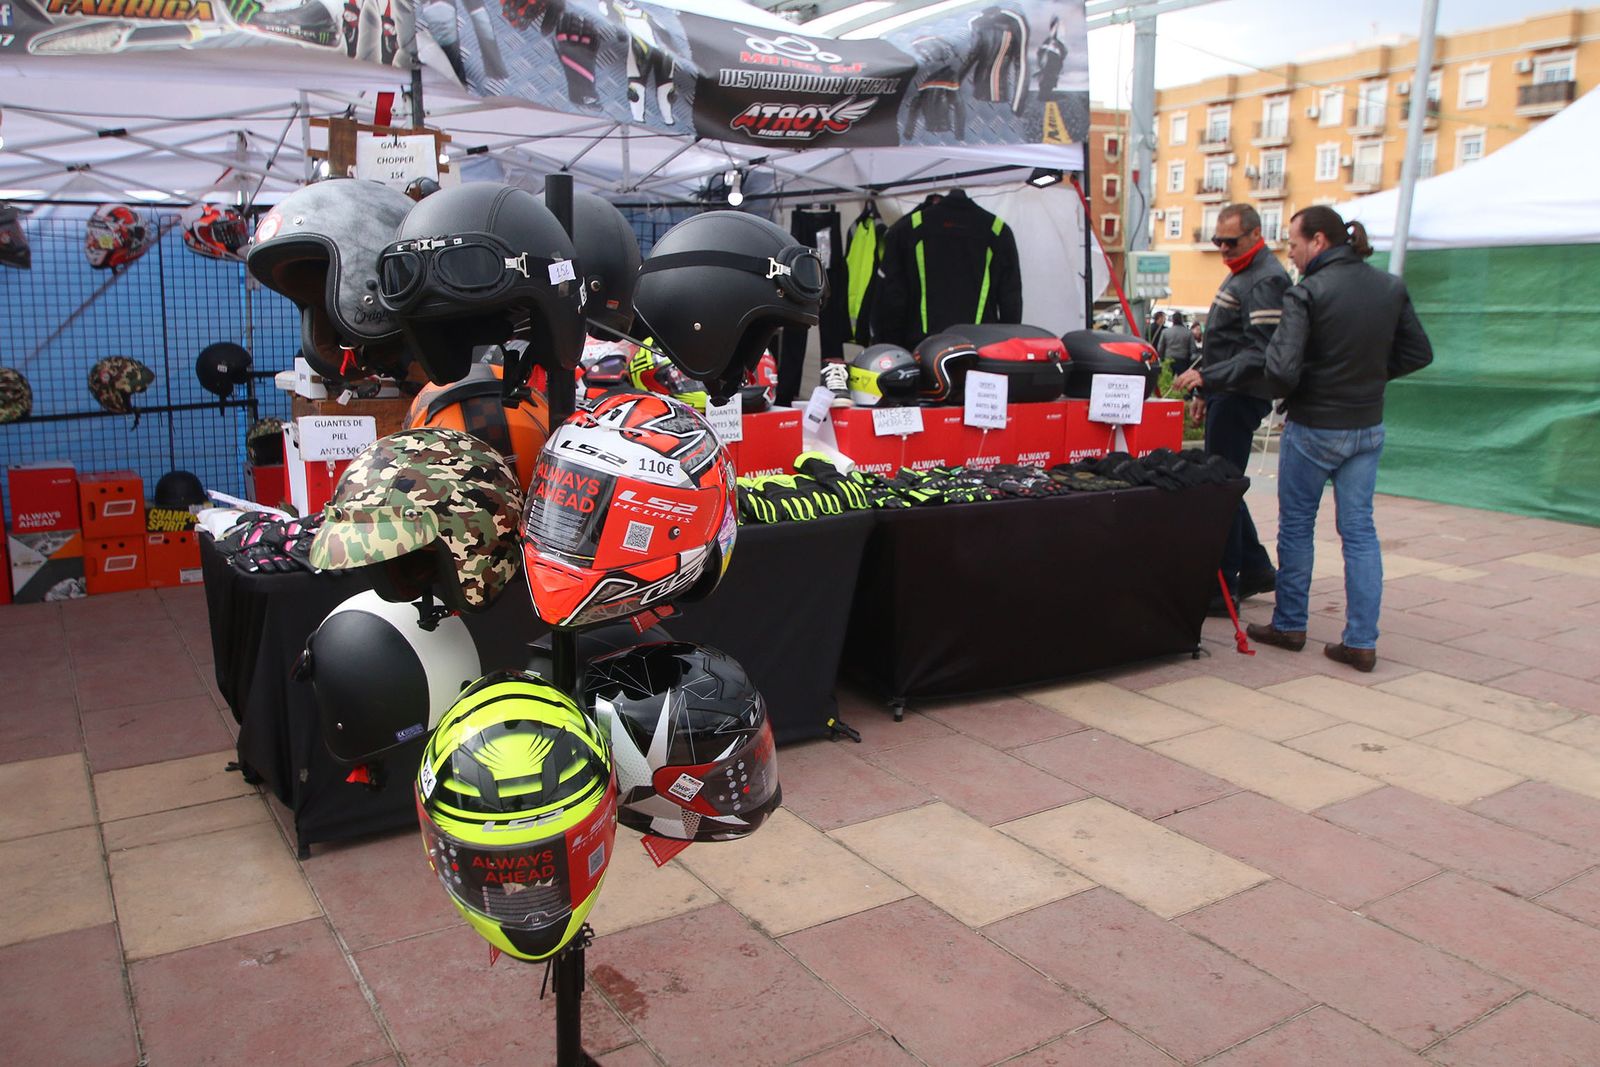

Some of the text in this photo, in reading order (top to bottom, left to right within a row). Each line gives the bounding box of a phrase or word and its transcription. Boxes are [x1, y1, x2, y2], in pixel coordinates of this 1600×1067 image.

[719, 68, 844, 94] DISTRIBUIDOR
[376, 156, 415, 165] CHOPPER
[314, 419, 363, 428] GUANTES DE
[332, 433, 348, 441] PIEL
[320, 447, 345, 456] ANTES
[560, 440, 628, 468] LS2
[1017, 451, 1051, 462] ALWAYS
[1069, 448, 1102, 459] ALWAYS
[638, 458, 675, 477] 110€
[965, 456, 1001, 467] ALWAYS
[537, 462, 600, 496] ALWAYS
[535, 482, 595, 514] AHEAD
[618, 490, 698, 516] LS2
[18, 510, 61, 522] ALWAYS
[613, 502, 692, 524] HELMETS
[18, 519, 56, 528] AHEAD
[147, 519, 188, 531] SPIRIT
[482, 808, 564, 832] LS2
[472, 850, 554, 870] ALWAYS
[485, 865, 556, 883] AHEAD
